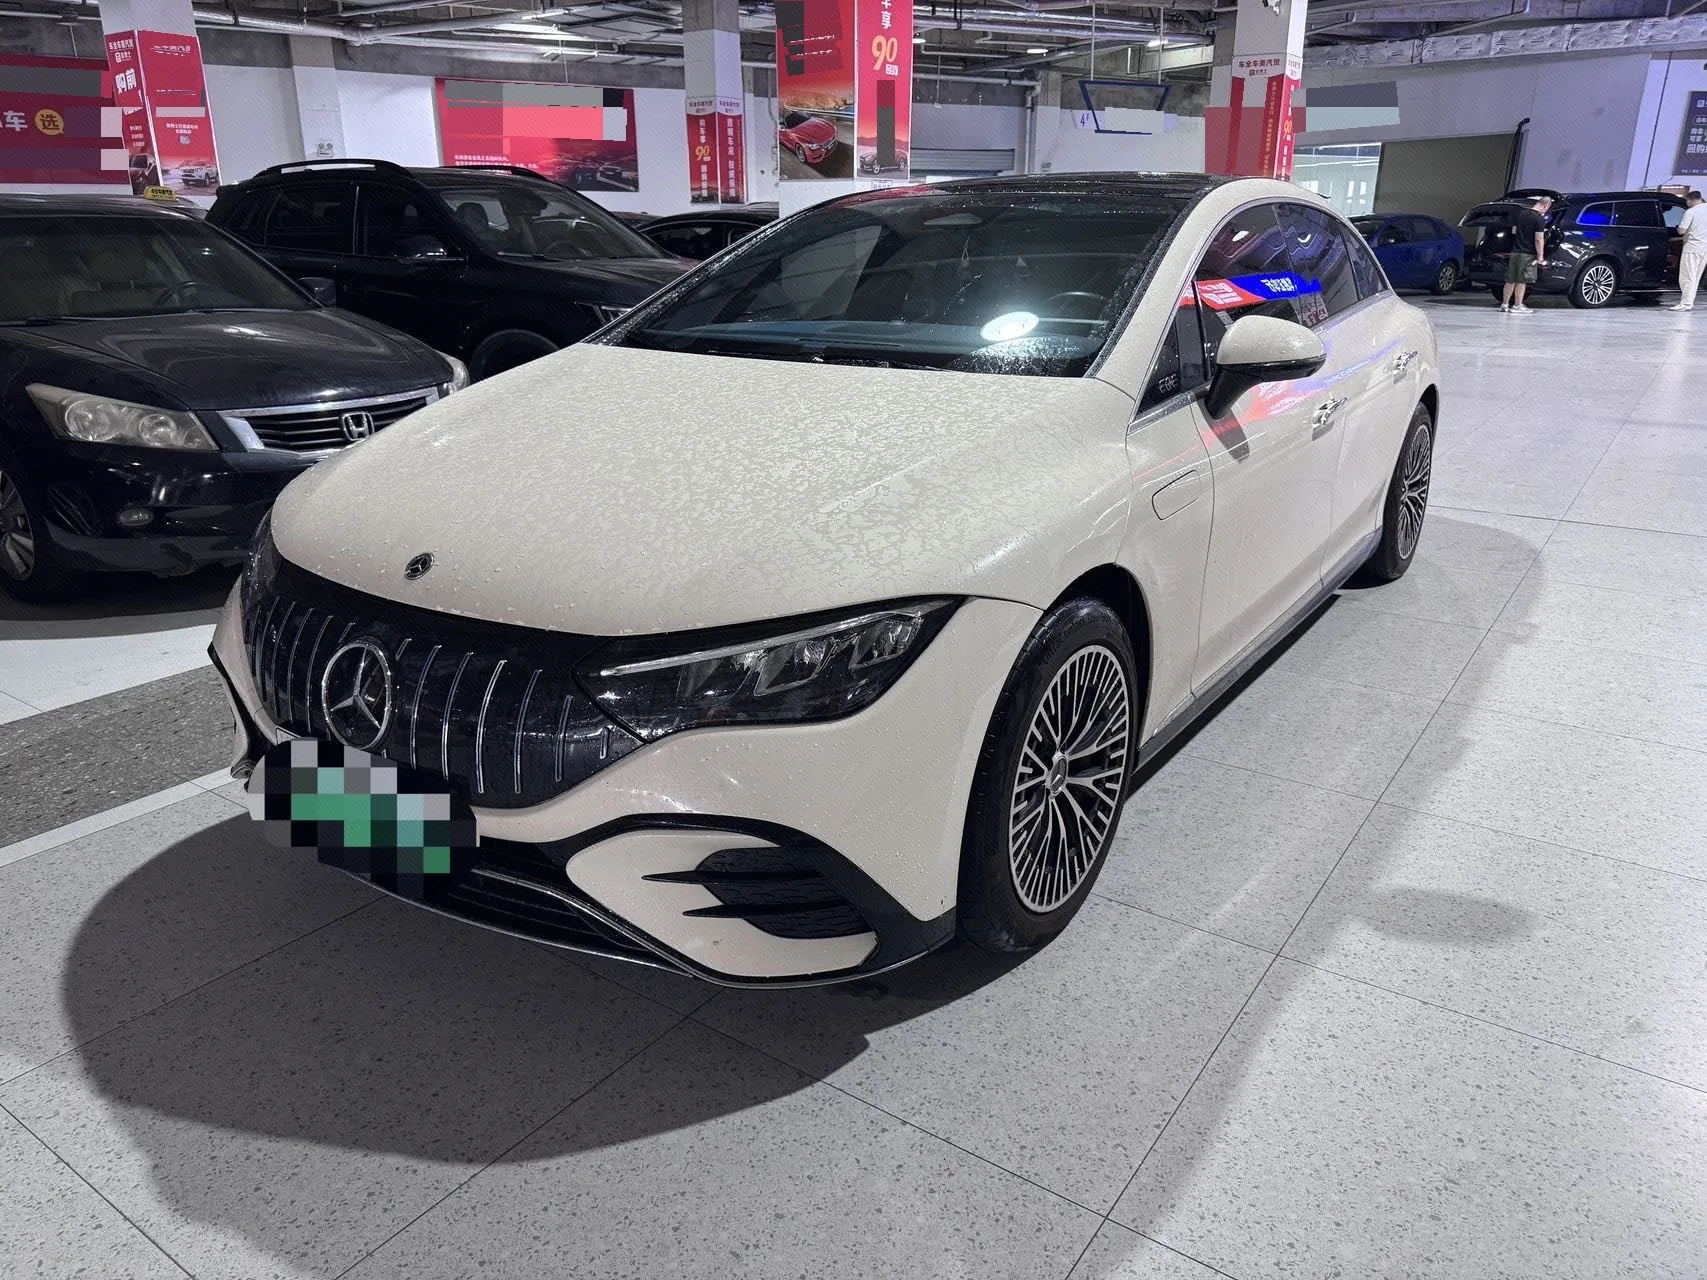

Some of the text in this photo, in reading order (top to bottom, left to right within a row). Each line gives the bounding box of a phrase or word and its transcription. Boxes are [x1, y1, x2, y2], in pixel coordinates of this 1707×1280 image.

[872, 35, 898, 71] 90
[0, 110, 60, 132] 车 选
[695, 146, 710, 161] 90
